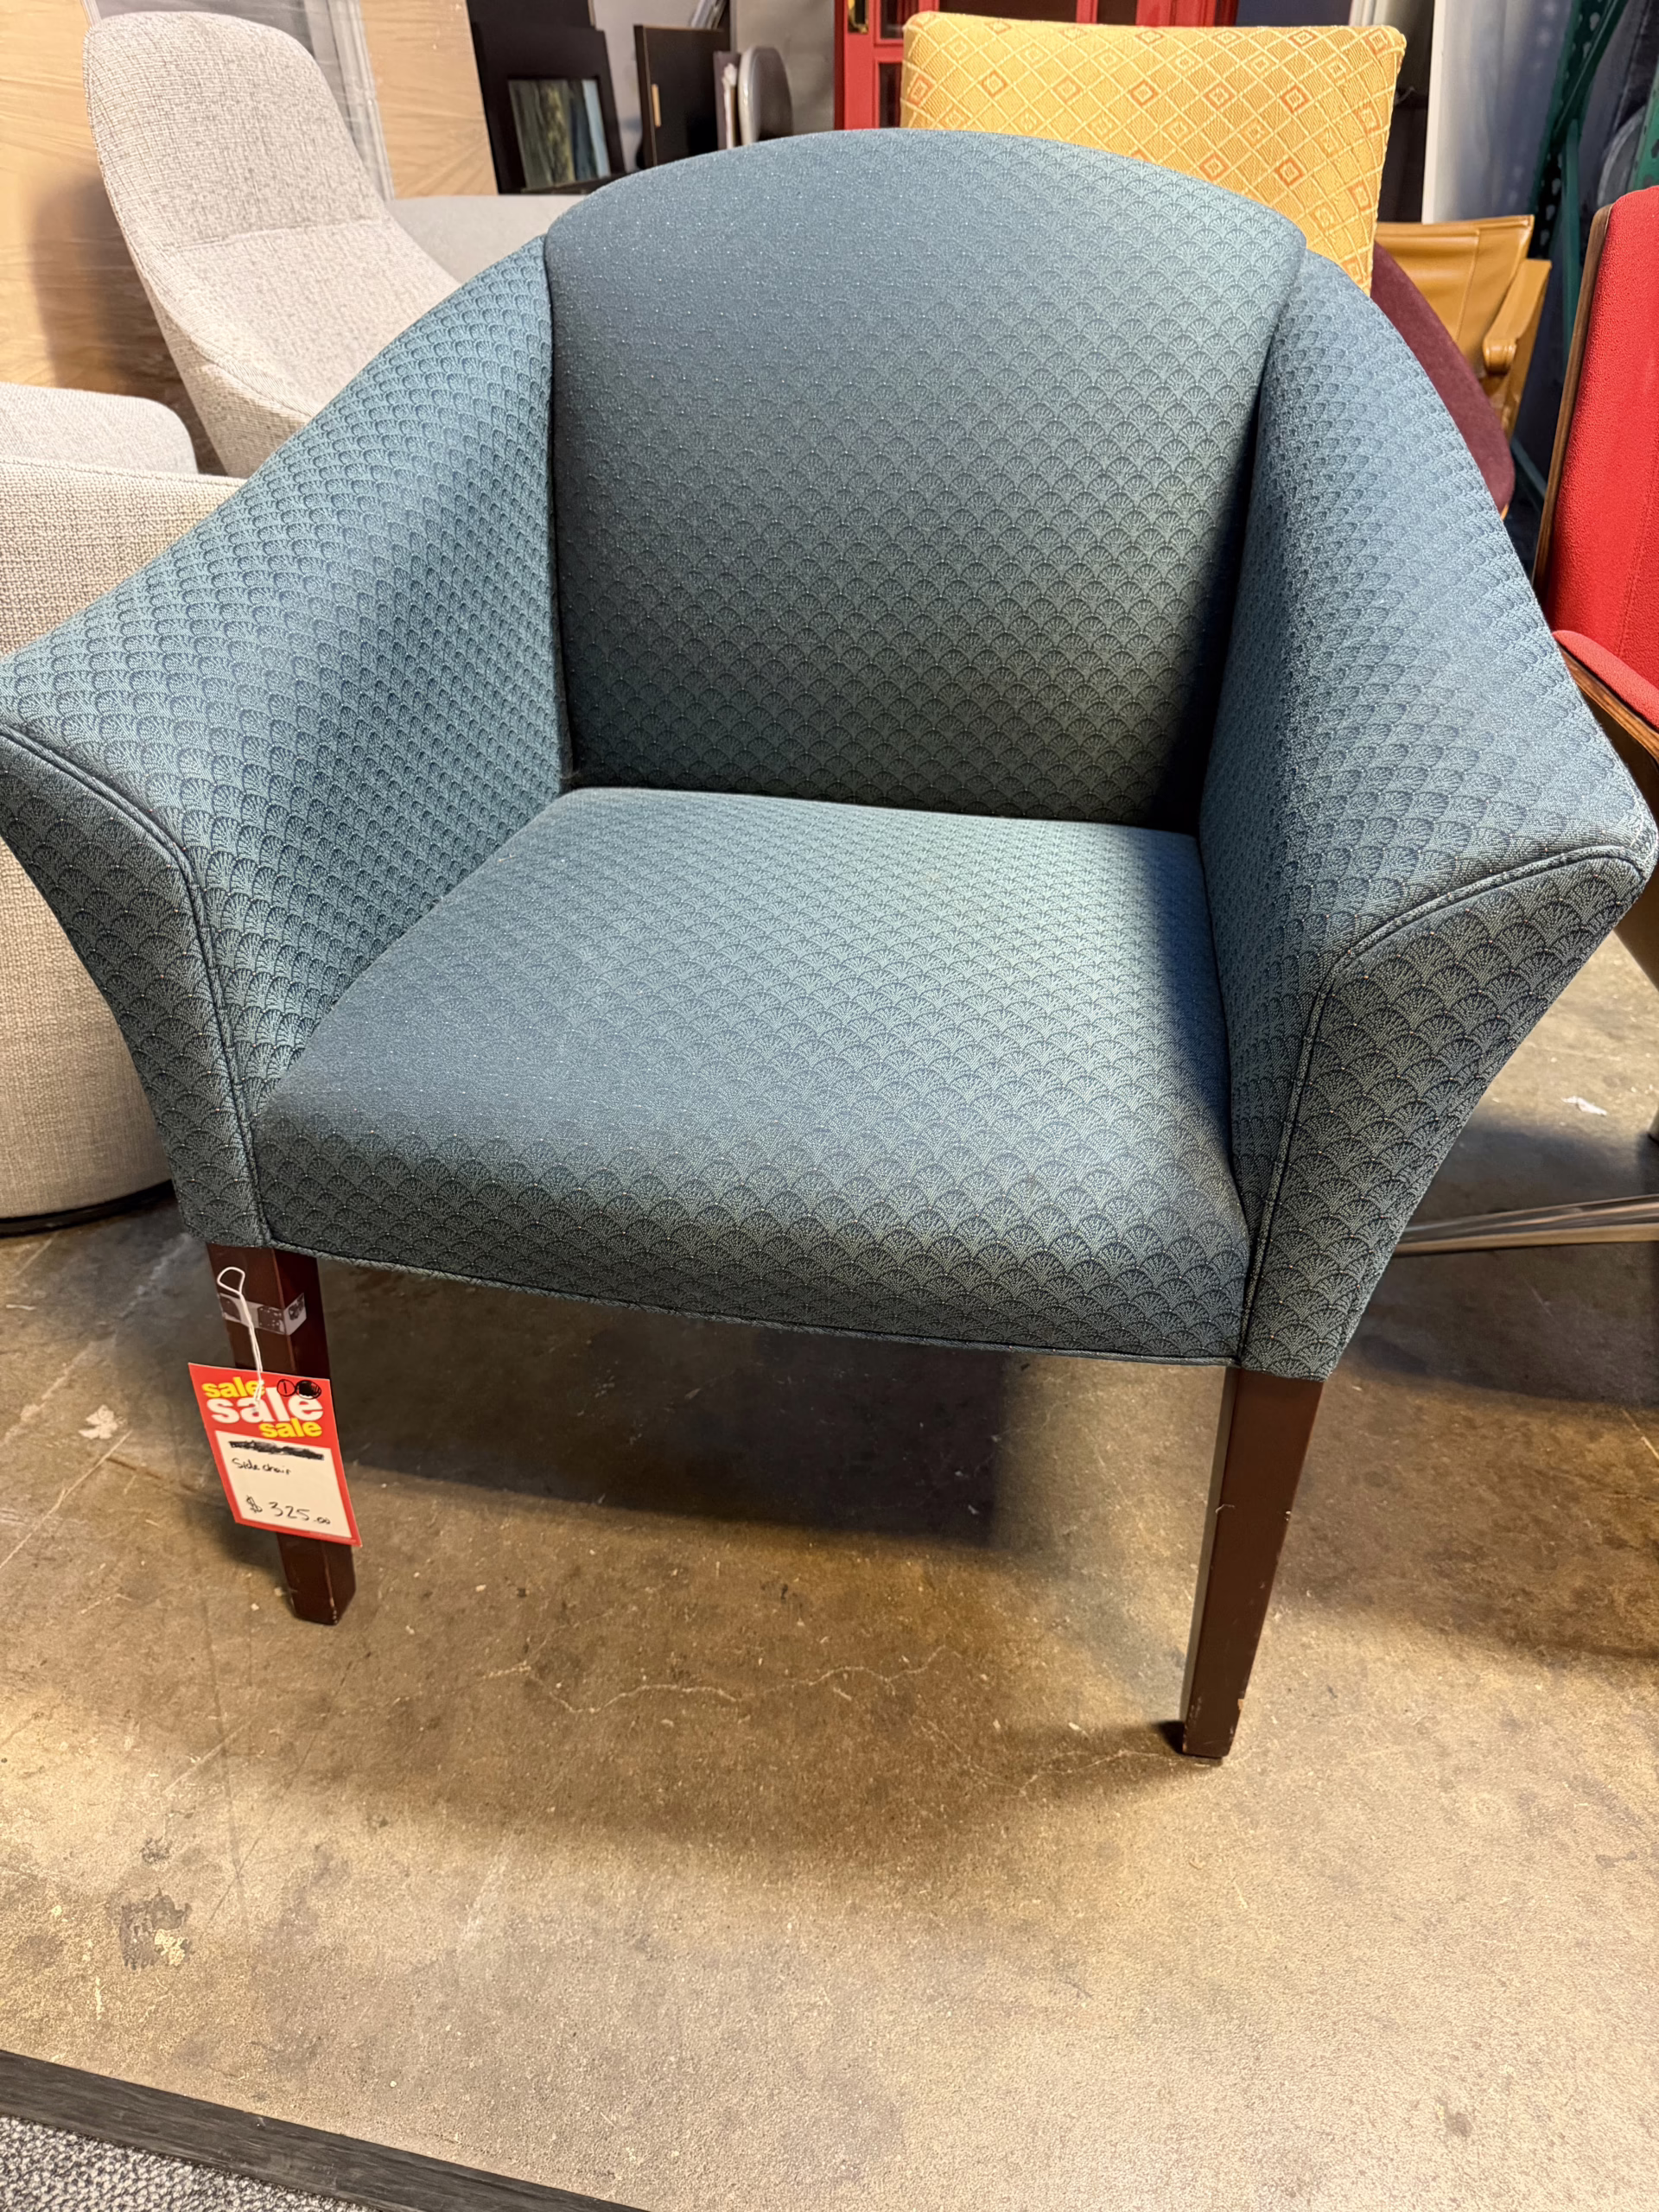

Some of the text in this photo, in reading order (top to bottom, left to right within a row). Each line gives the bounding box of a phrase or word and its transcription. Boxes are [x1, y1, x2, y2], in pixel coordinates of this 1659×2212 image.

[201, 1376, 265, 1398] sale
[207, 1387, 324, 1424] sale
[259, 1418, 322, 1438] sale
